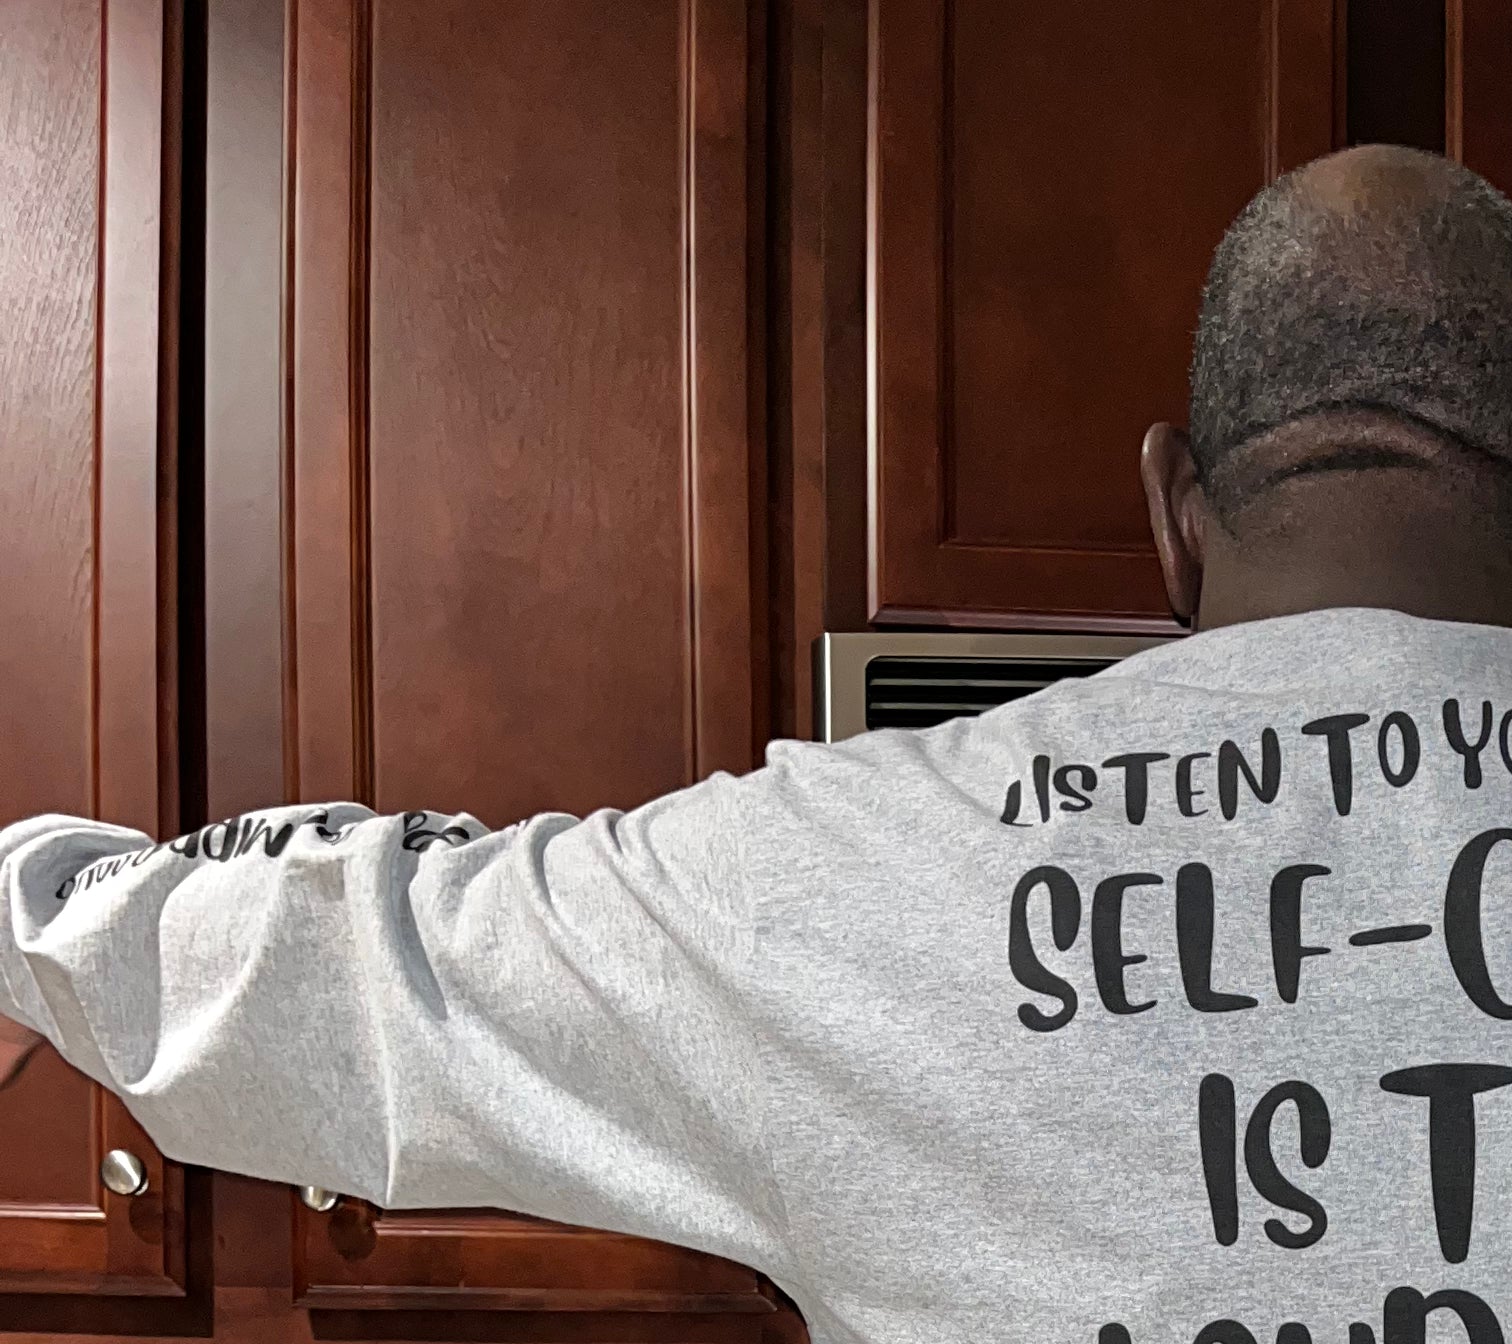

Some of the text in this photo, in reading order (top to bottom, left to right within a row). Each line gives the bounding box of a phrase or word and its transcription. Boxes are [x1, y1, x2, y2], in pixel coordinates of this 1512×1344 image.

[1000, 727, 1282, 827] LISTEN
[1302, 711, 1421, 817] TO
[1199, 1073, 1332, 1250] IS
